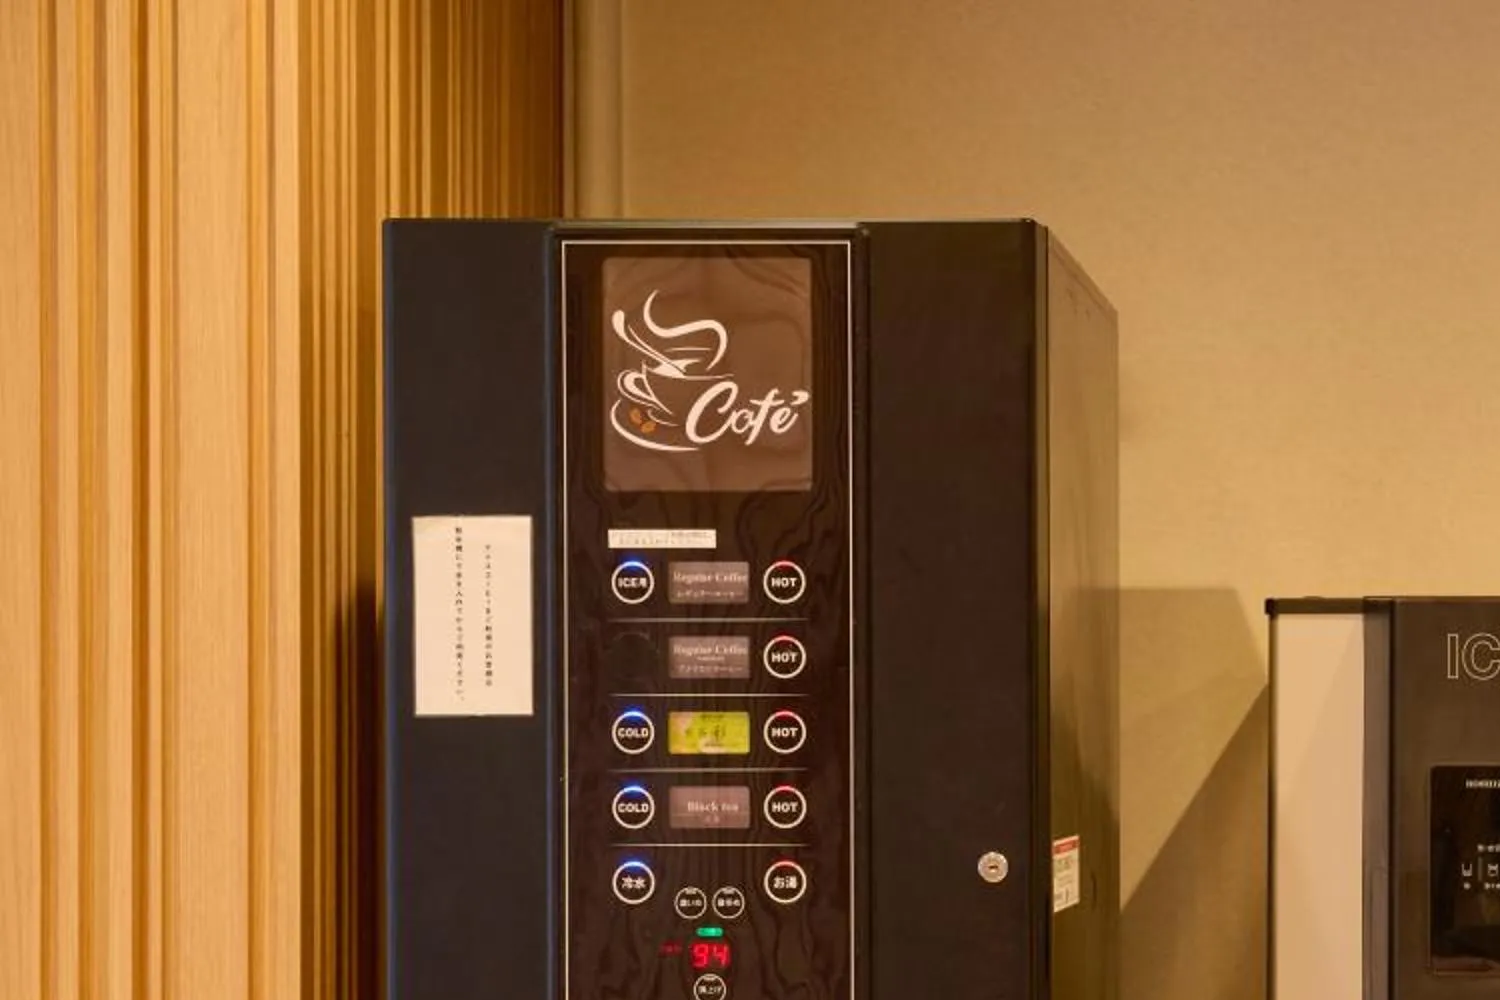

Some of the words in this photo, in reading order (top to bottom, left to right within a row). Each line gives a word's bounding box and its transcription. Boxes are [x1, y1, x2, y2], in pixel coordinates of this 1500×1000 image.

[771, 576, 798, 588] HOT
[771, 652, 798, 663] HOT
[617, 726, 649, 738] COLD
[771, 726, 798, 738] HOT
[617, 802, 649, 814] COLD
[687, 801, 719, 812] Black
[720, 803, 740, 812] tea
[771, 802, 799, 813] HOT
[773, 876, 798, 889] お湯
[692, 943, 729, 969] 94
